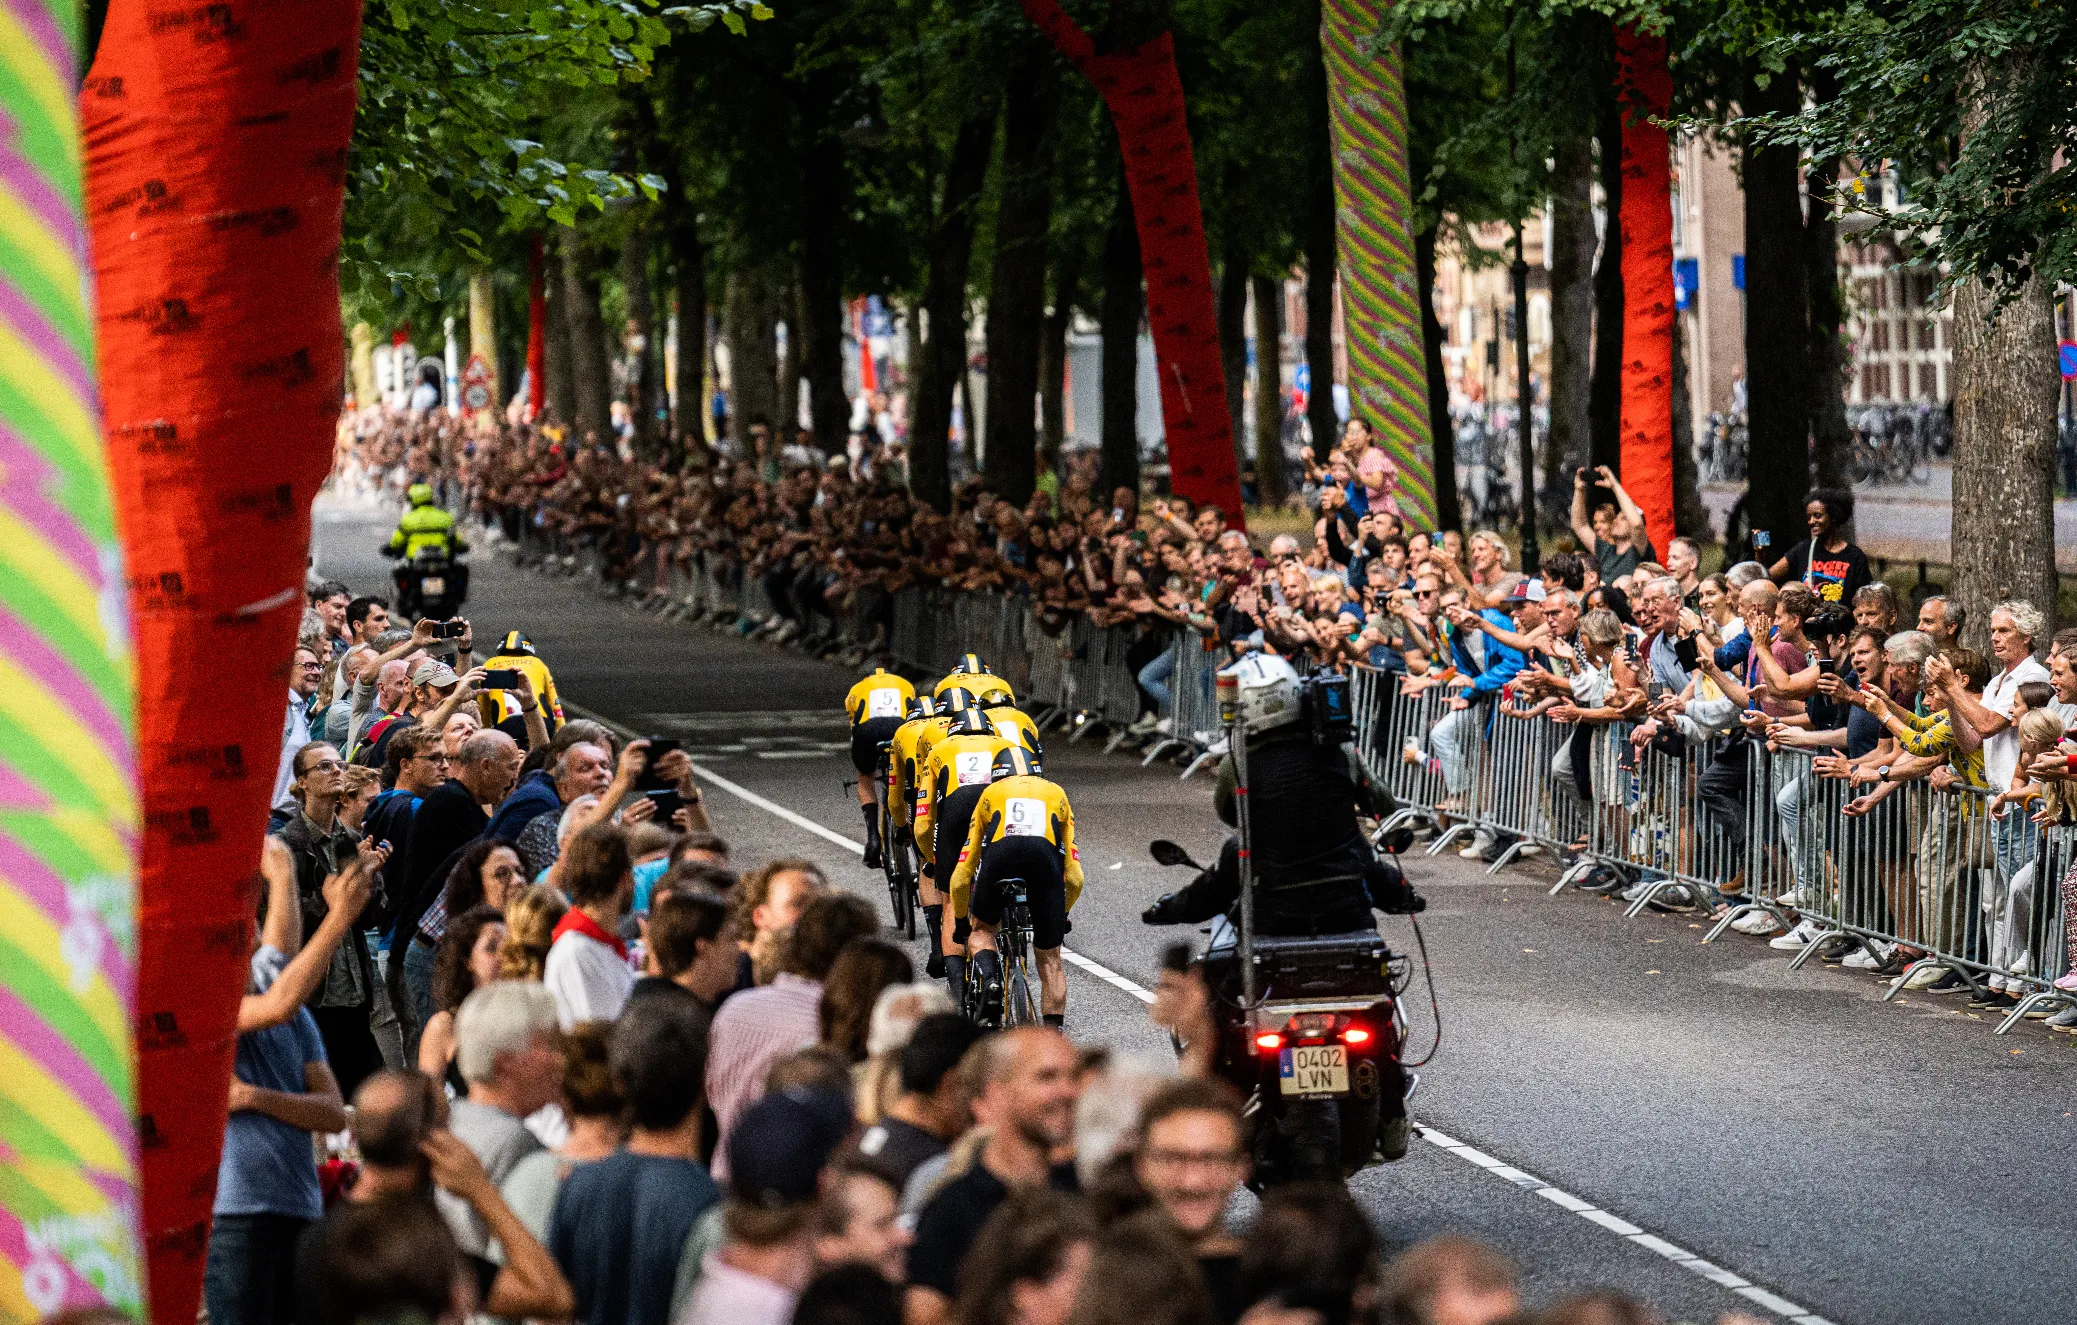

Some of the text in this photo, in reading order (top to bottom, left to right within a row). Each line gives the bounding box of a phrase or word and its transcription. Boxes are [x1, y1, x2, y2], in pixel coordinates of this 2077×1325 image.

[883, 692, 893, 706] 5
[968, 756, 979, 772] 2
[1012, 801, 1025, 822] 6
[1297, 1048, 1343, 1069] 0402
[1297, 1069, 1333, 1089] LVN
